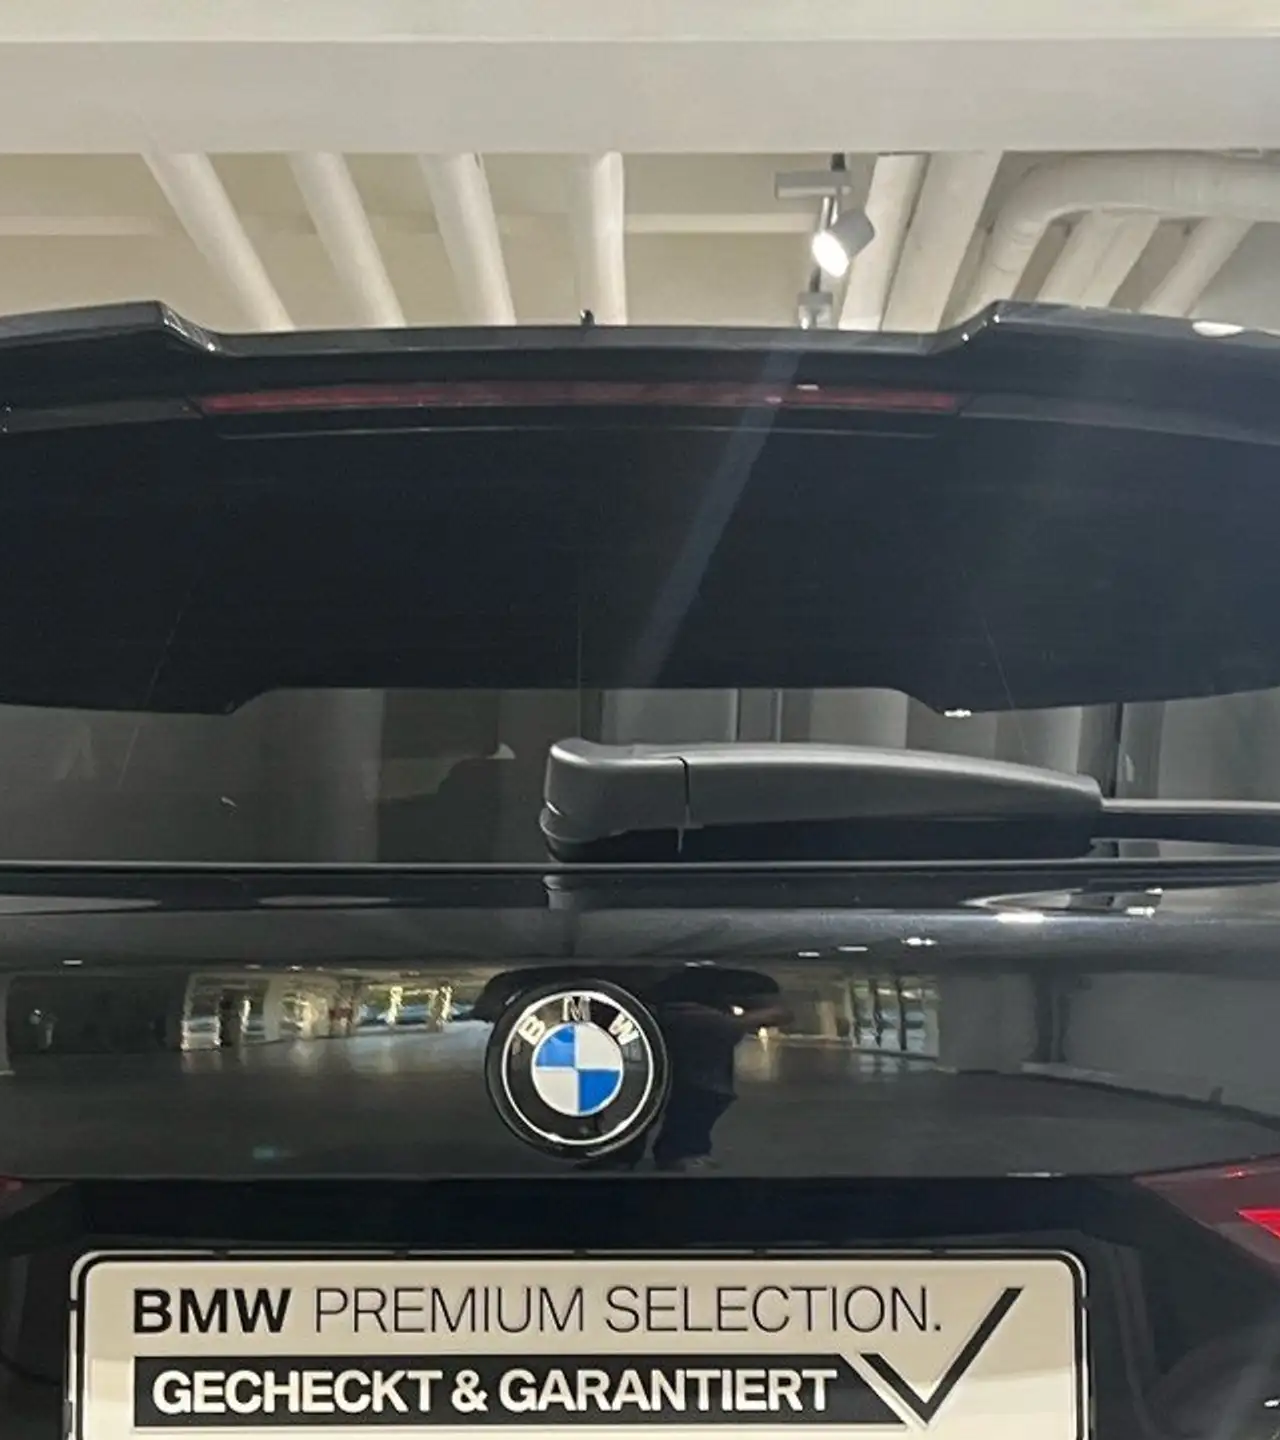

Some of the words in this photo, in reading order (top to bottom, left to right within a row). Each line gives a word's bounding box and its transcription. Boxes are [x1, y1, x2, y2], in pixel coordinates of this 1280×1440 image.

[518, 995, 641, 1047] BMW
[132, 1287, 292, 1334] BMW
[314, 1286, 585, 1334] PREMIUM
[604, 1285, 942, 1333] SELECTION.
[152, 1369, 443, 1414] GECHECKT
[450, 1368, 488, 1413] &
[498, 1368, 838, 1414] GARANTIERT
